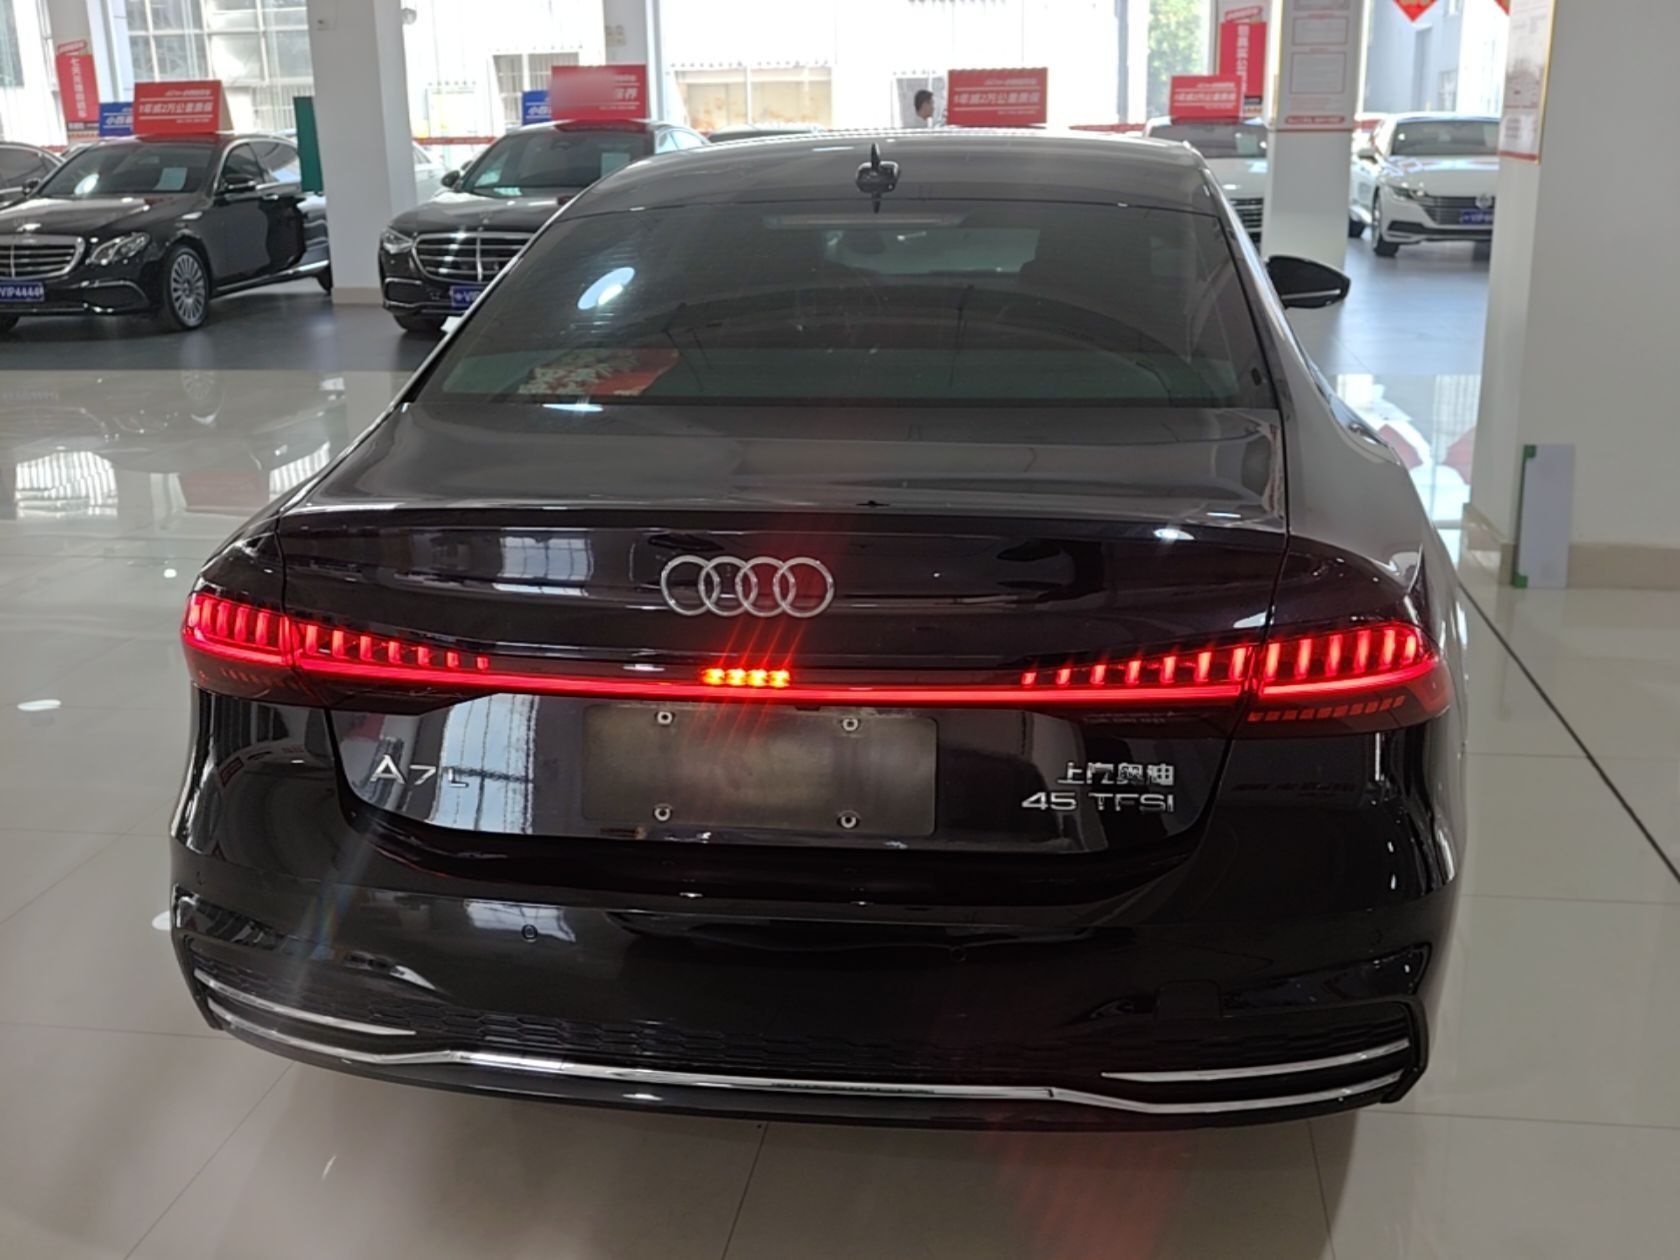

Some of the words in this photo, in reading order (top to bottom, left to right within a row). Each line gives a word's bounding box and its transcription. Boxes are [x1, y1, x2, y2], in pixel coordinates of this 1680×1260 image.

[370, 754, 469, 788] A7L
[1057, 762, 1174, 785] 上汽奥迪
[1021, 791, 1077, 810] 45
[1088, 793, 1174, 812] TFSI
